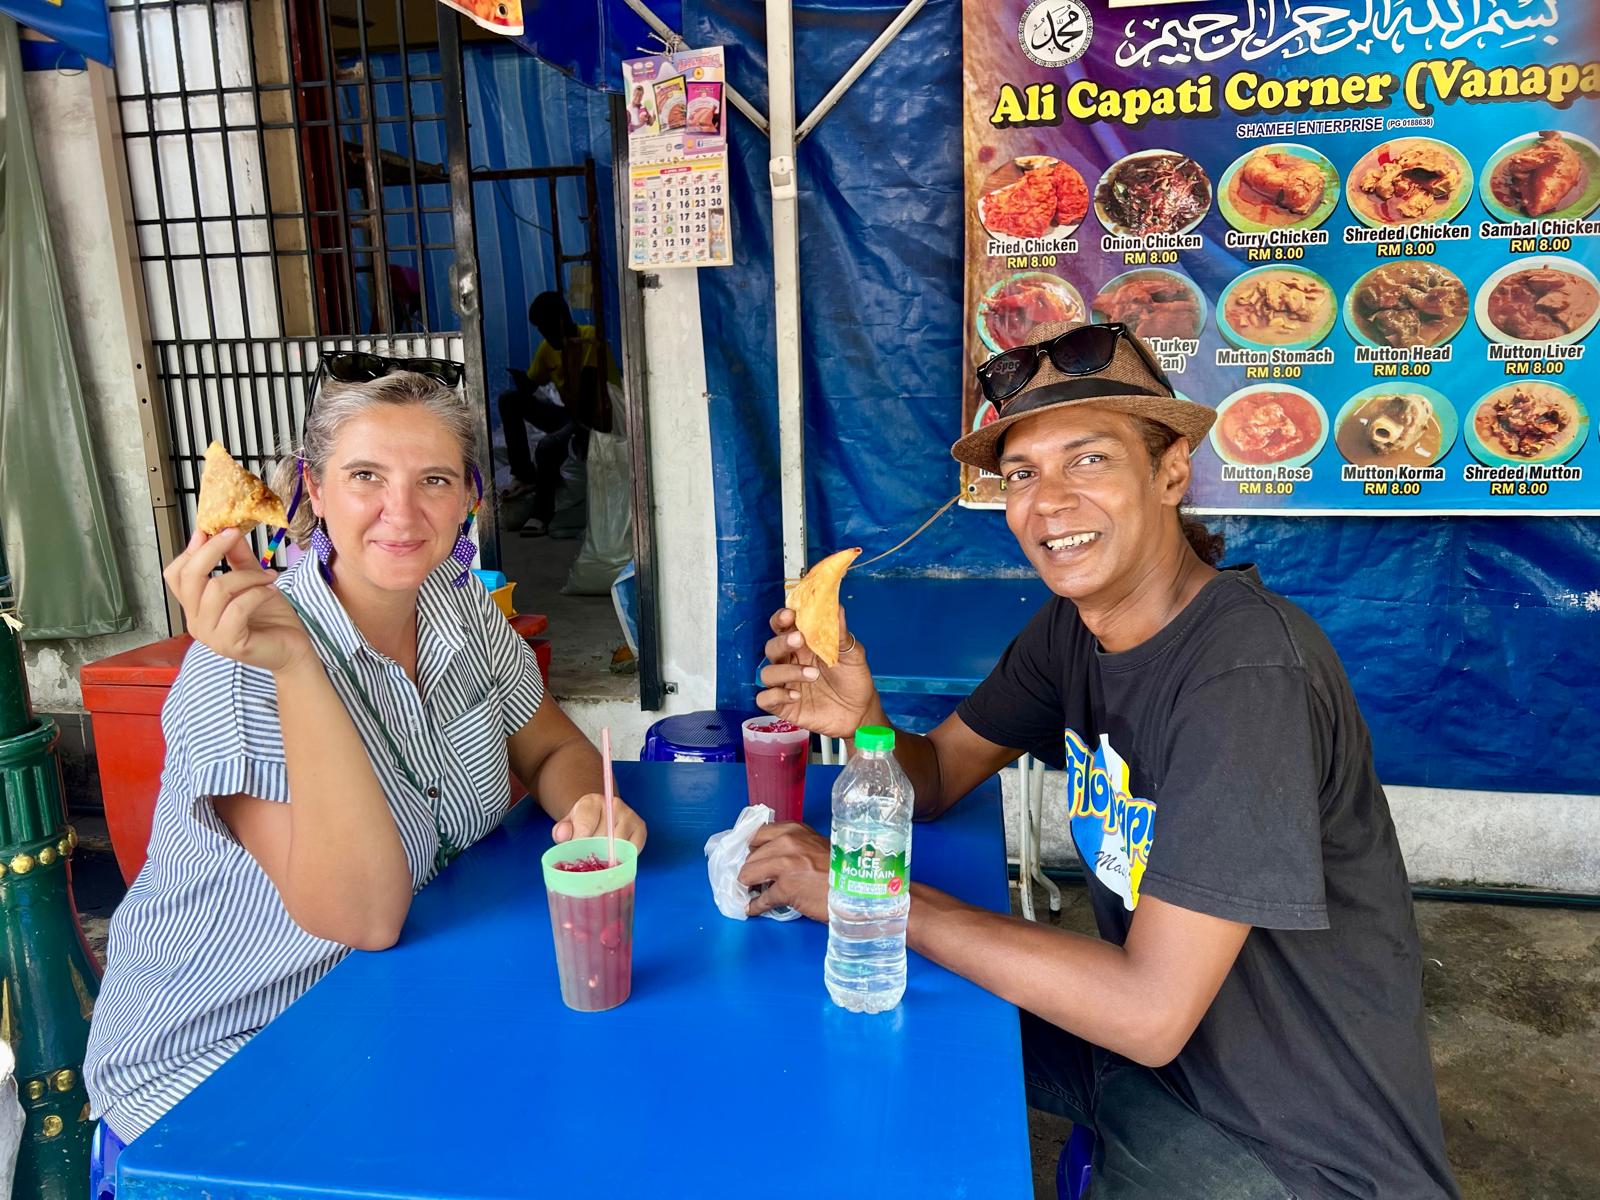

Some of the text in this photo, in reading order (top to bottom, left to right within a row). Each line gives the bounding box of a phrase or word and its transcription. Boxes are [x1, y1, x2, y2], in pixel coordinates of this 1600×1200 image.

[990, 83, 1057, 124] Ali
[1067, 74, 1214, 125] Capati
[1224, 69, 1393, 112] Corner
[1237, 124, 1294, 137] SHAMEE
[1298, 118, 1383, 134] ENTERPRISE
[1387, 120, 1401, 128] (PG
[679, 188, 690, 196] 15
[694, 187, 705, 195] 22
[710, 185, 721, 193] 29
[695, 199, 706, 207] 23
[711, 198, 722, 206] 30
[680, 225, 690, 233] 18
[695, 224, 706, 232] 25
[1345, 225, 1469, 242] Shreded Chicken
[1481, 220, 1600, 237] Sambal Chicken
[665, 239, 675, 247] 12
[680, 238, 691, 246] 19
[1103, 235, 1201, 250] Onion Chicken
[1227, 231, 1327, 246] Curry Chicken
[1511, 238, 1571, 252] RM 8.00
[989, 239, 1077, 254] Fried Chicken
[1377, 243, 1435, 256] RM 8.00
[1125, 251, 1178, 264] RM 8.00
[1248, 247, 1304, 260] RM 8.00
[1007, 255, 1056, 268] RM 8.00
[1151, 339, 1197, 354] Turkey
[1489, 345, 1583, 359] Mutton Liver
[1217, 350, 1333, 364] Mutton Stomach
[1356, 346, 1450, 361] Mutton Head
[1246, 366, 1301, 378] RM 8.00
[1373, 364, 1430, 376] RM 8.00
[1505, 361, 1564, 374] RM 8.00
[1223, 467, 1311, 479] Mutton Rose
[1343, 467, 1444, 480] Mutton Korma
[1465, 467, 1580, 480] Shreded Mutton
[1239, 482, 1293, 494] RM 8.00
[1364, 482, 1421, 494] RM 8.00
[1491, 482, 1548, 494] RM 8.00
[857, 856, 881, 869] ICE
[842, 866, 896, 879] MOUNTAIN
